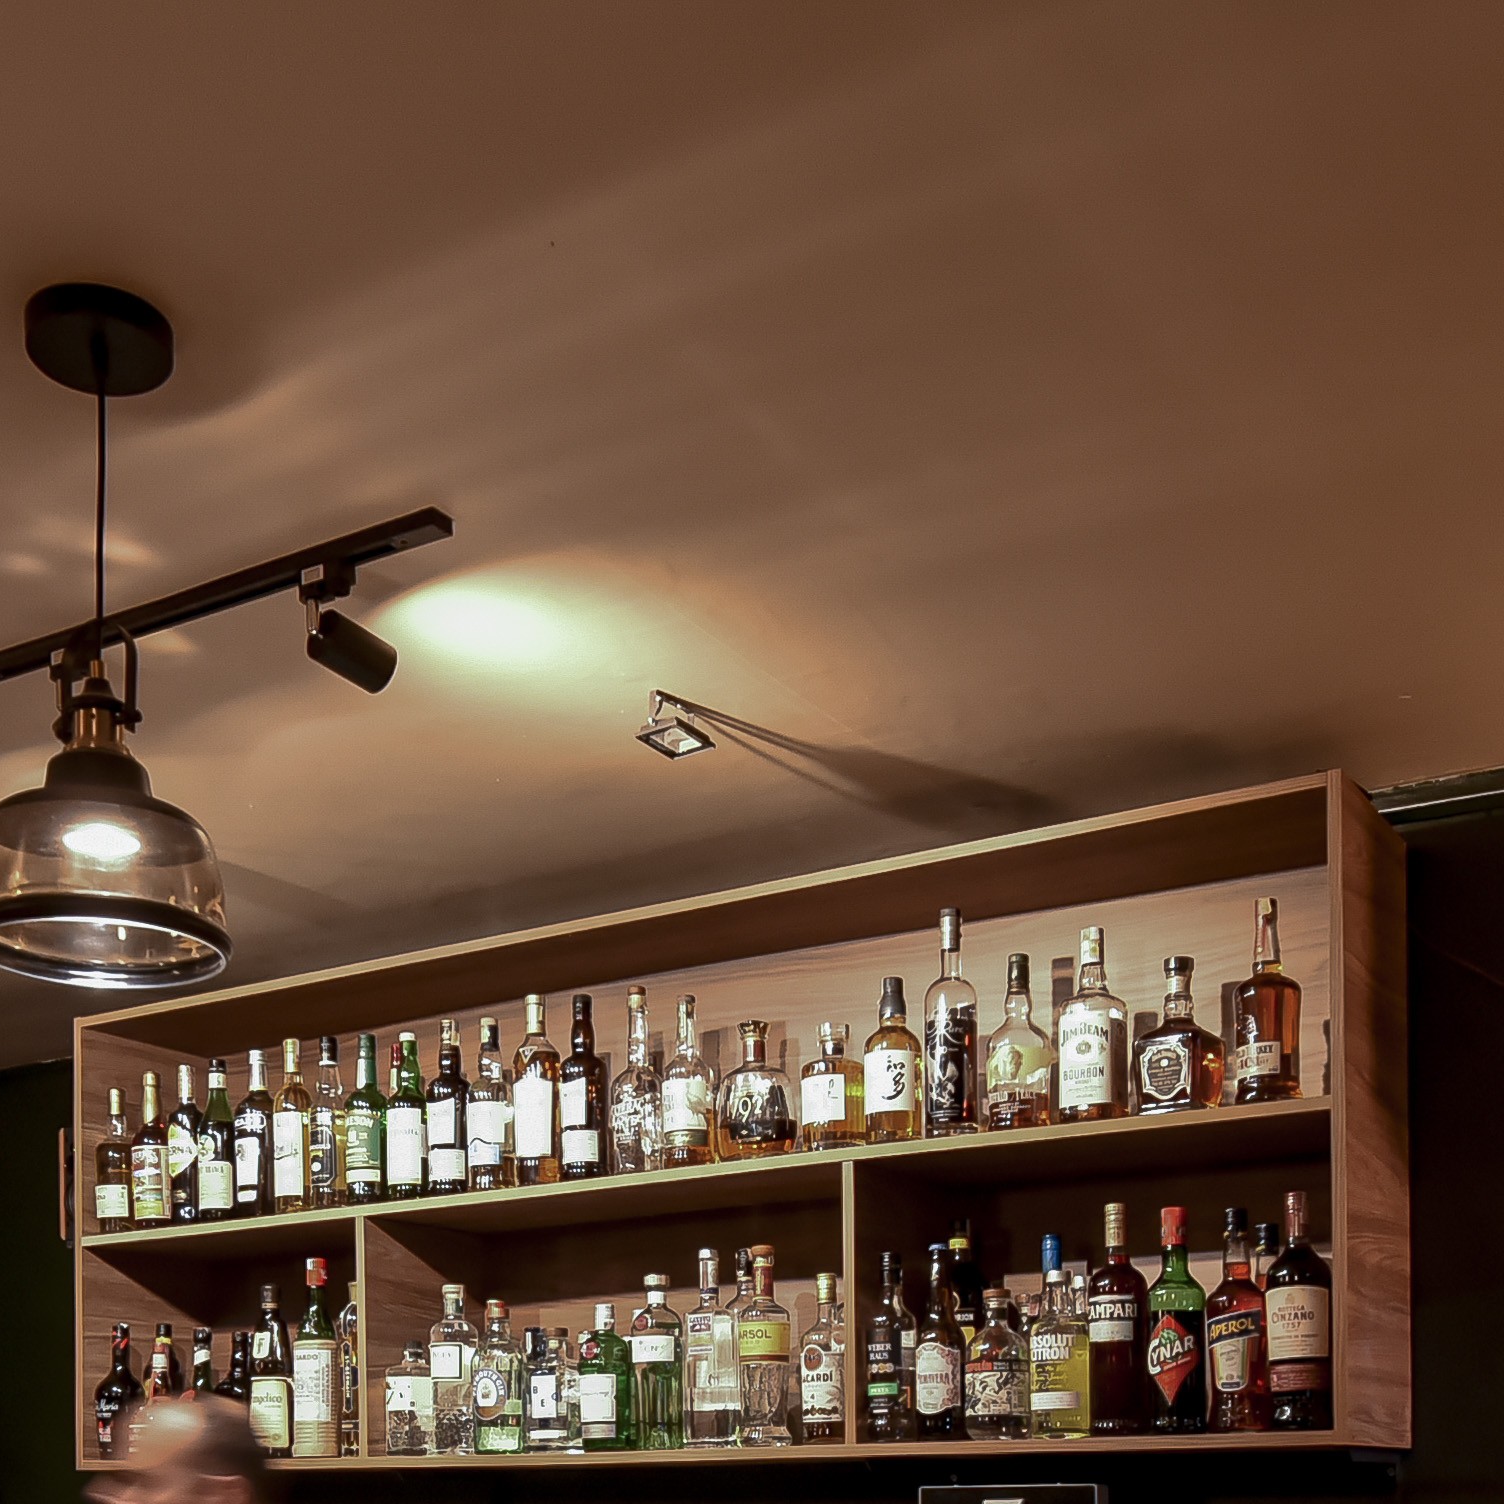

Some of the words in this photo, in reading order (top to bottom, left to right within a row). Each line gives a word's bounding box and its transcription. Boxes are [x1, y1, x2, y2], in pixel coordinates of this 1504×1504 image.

[1061, 1028, 1078, 1047] JIM
[1080, 1022, 1108, 1042] BEAM
[1063, 1066, 1104, 1081] BOURBON
[739, 1329, 772, 1340] ARSOL
[1210, 1317, 1255, 1341] APEROL
[1148, 1335, 1194, 1374] CYNAR
